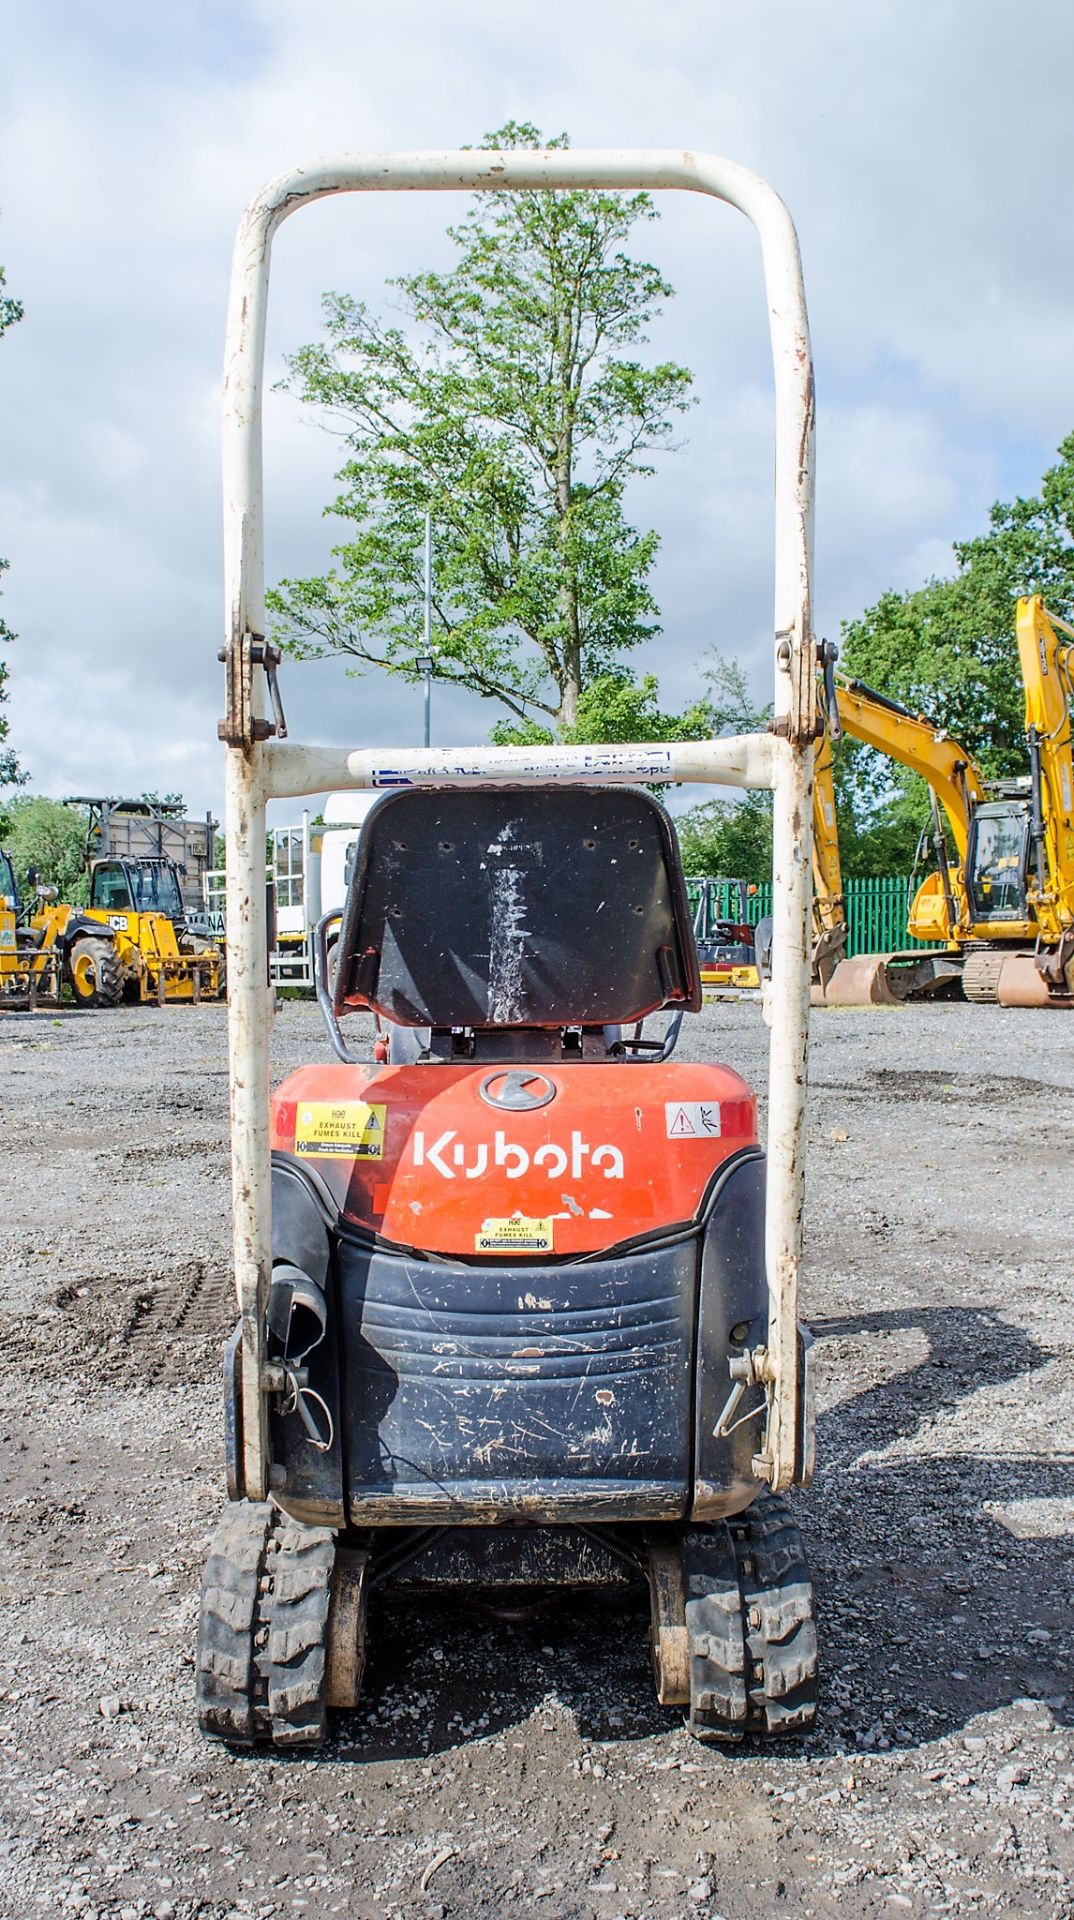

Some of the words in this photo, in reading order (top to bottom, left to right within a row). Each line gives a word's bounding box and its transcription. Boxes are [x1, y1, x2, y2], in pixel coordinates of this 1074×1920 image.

[106, 915, 128, 931] JCB
[319, 1122, 356, 1130] EXHAUST
[413, 1131, 624, 1179] Kubota
